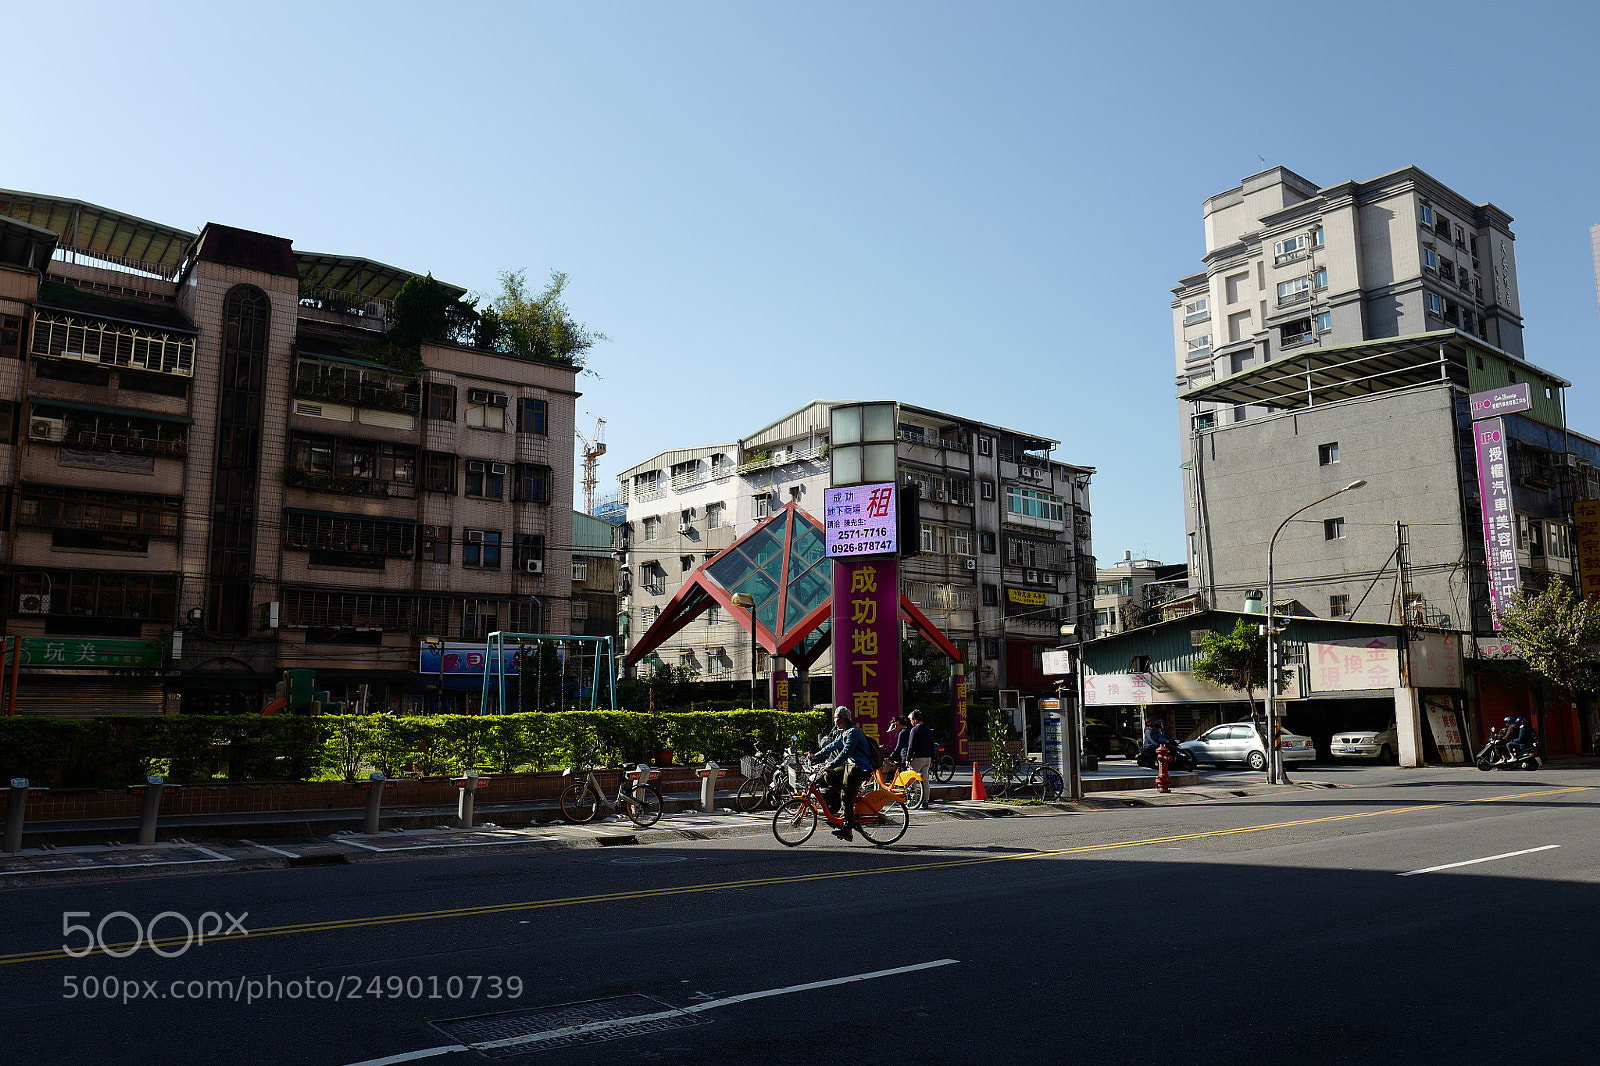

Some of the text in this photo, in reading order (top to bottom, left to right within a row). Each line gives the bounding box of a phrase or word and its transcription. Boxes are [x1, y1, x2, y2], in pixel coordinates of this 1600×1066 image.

[1482, 430, 1501, 444] IPO
[834, 490, 854, 503] 成功
[867, 487, 893, 519] 租
[838, 527, 887, 540] 2571-7716
[832, 540, 892, 554] 0926-878747
[43, 641, 97, 663] 玩美
[1343, 654, 1363, 675] 換
